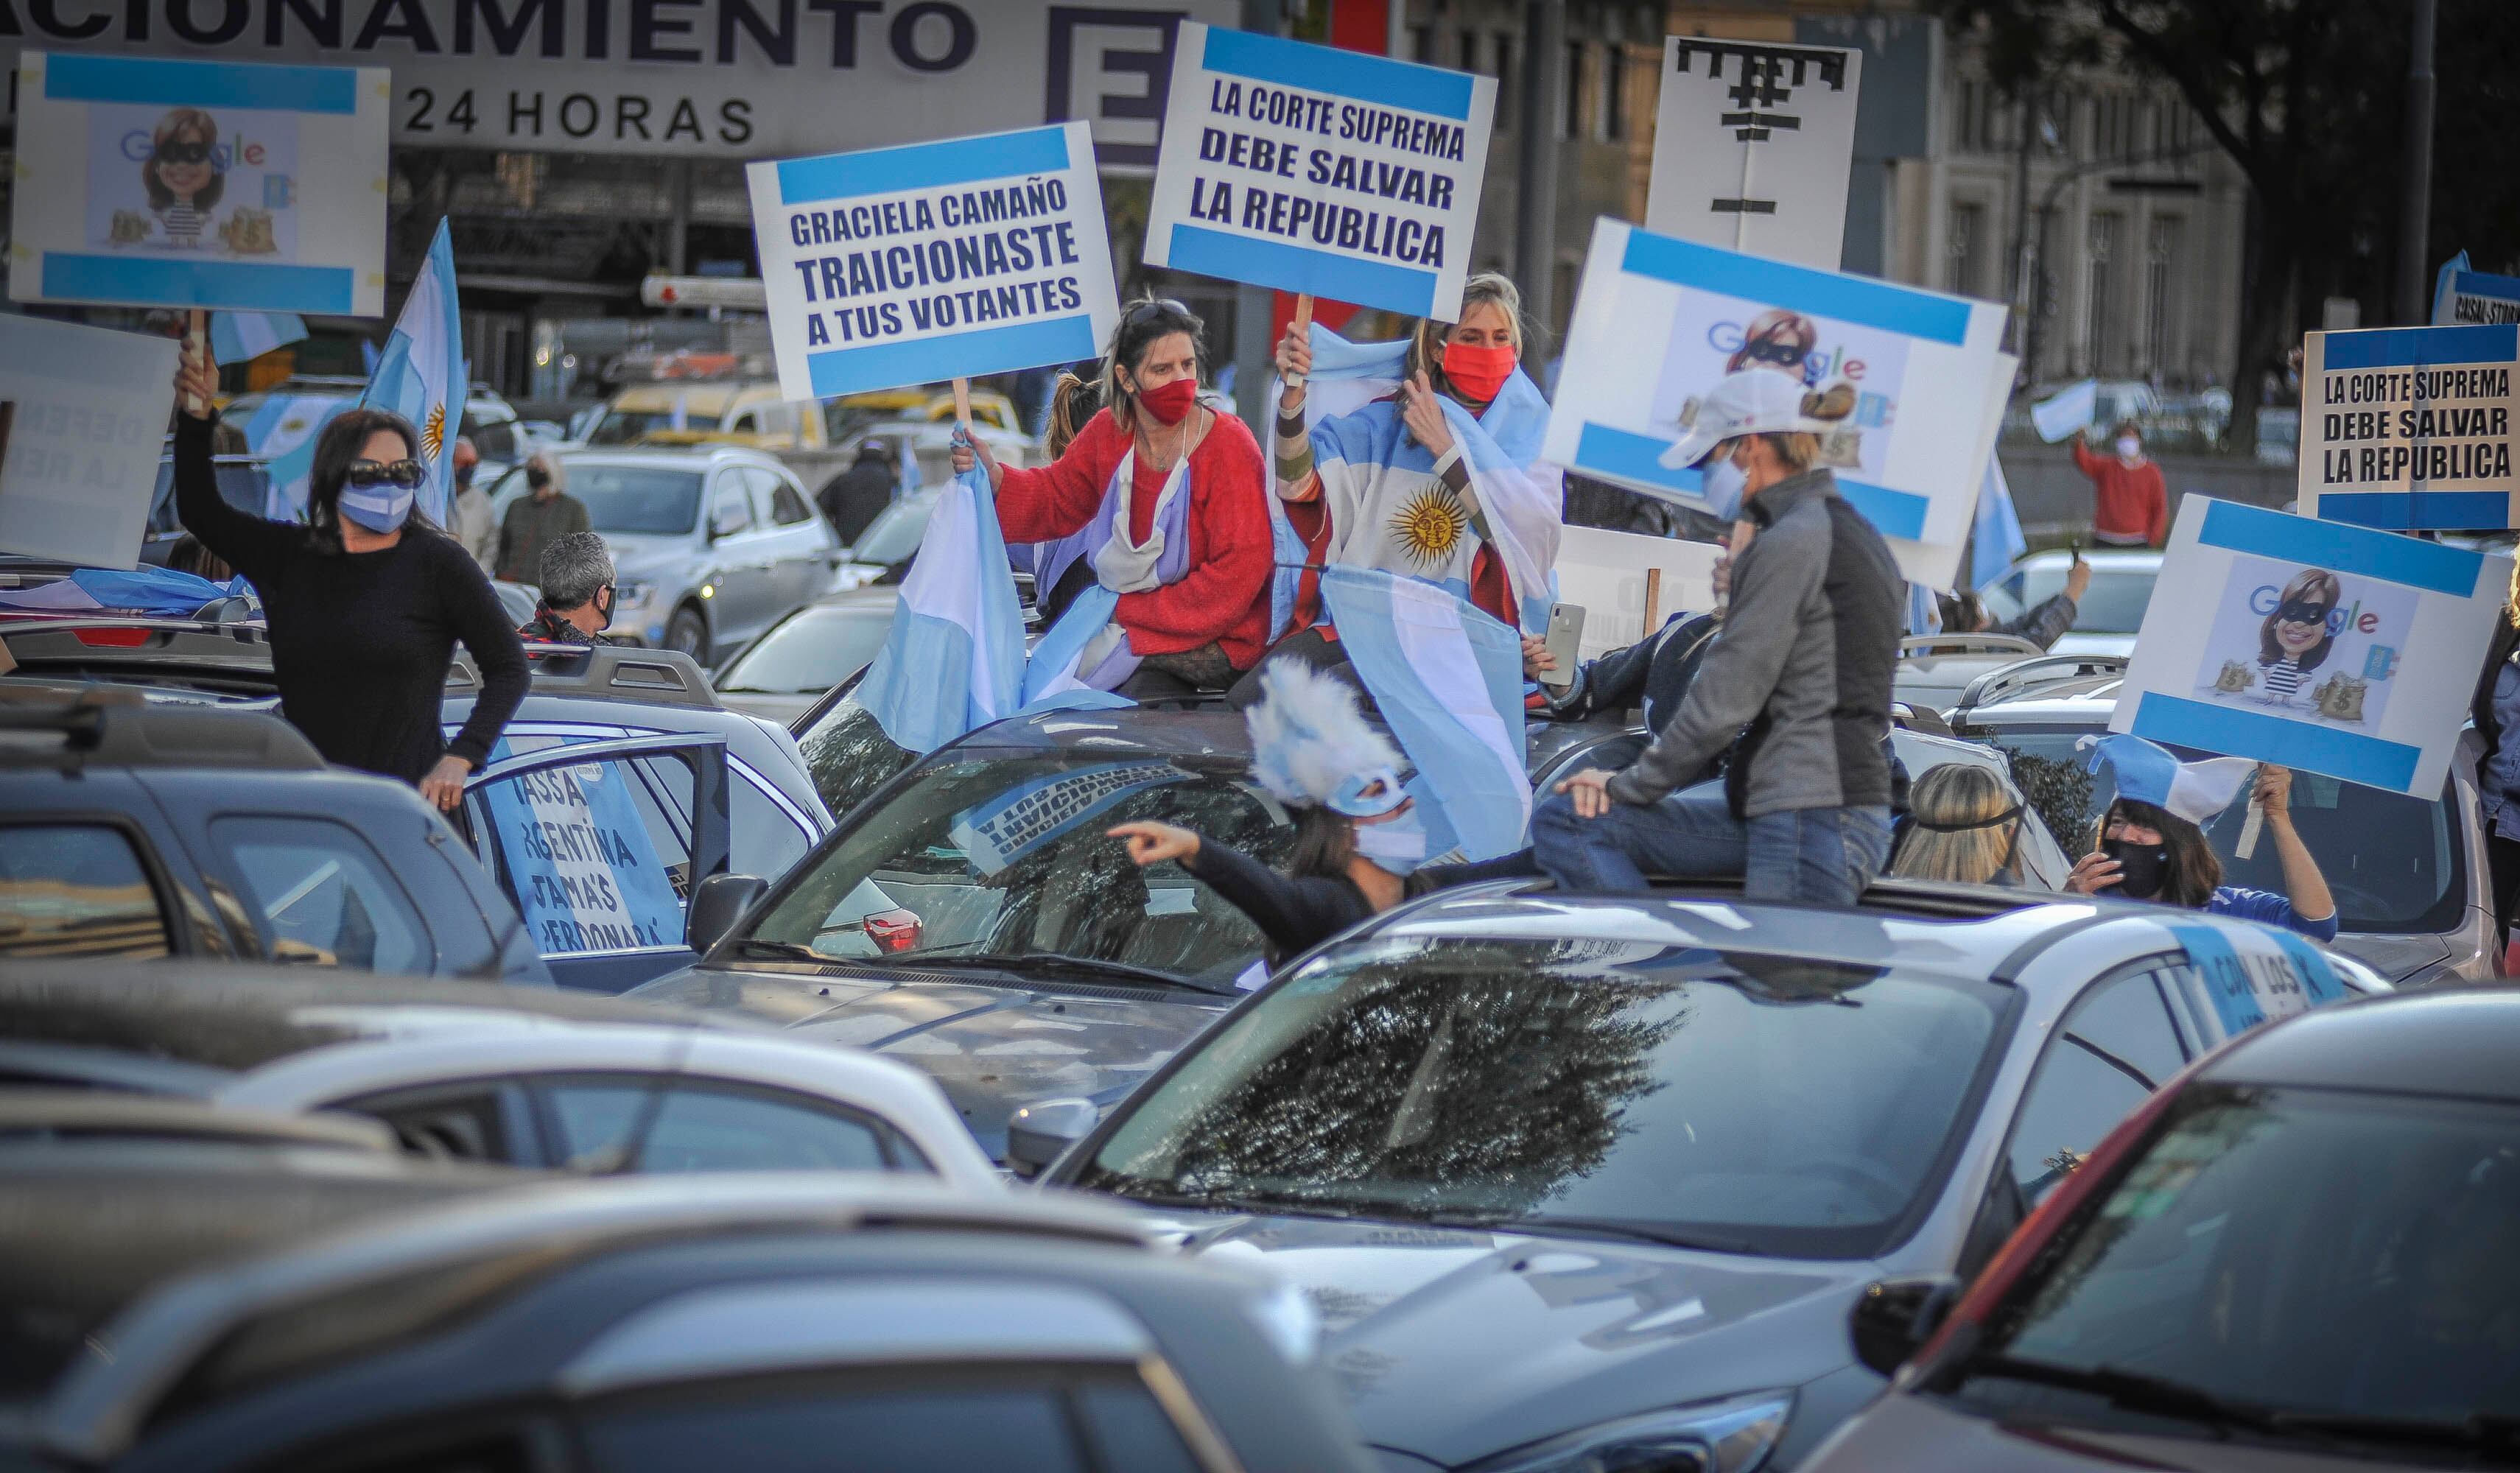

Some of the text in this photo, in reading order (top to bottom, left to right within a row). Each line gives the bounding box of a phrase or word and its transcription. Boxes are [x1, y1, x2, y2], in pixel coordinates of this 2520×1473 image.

[0, 0, 978, 71] CIONAMIENTO
[1070, 24, 1162, 146] E
[405, 88, 753, 144] 24 HORAS
[1210, 78, 1465, 162] LA CORTE SUPREMA
[121, 130, 265, 173] Ggle
[1199, 127, 1455, 211] DEBE SALVAR
[790, 176, 1067, 247] GRACIELA CAMAÑO
[1190, 177, 1445, 269] LA REPUBLICA
[795, 221, 1080, 303] TRAICIONASTE
[807, 277, 1082, 346] A TUS VOTANTES
[1708, 321, 1866, 381] Ggle
[2325, 369, 2510, 404] LA CORTE SUPREMA
[2323, 407, 2507, 442] DEBE SALVAR
[2323, 443, 2512, 483] LA REPUBLICA
[2250, 585, 2379, 637] Ggle
[511, 769, 589, 806] ASSA
[521, 818, 638, 868] RGENTINA
